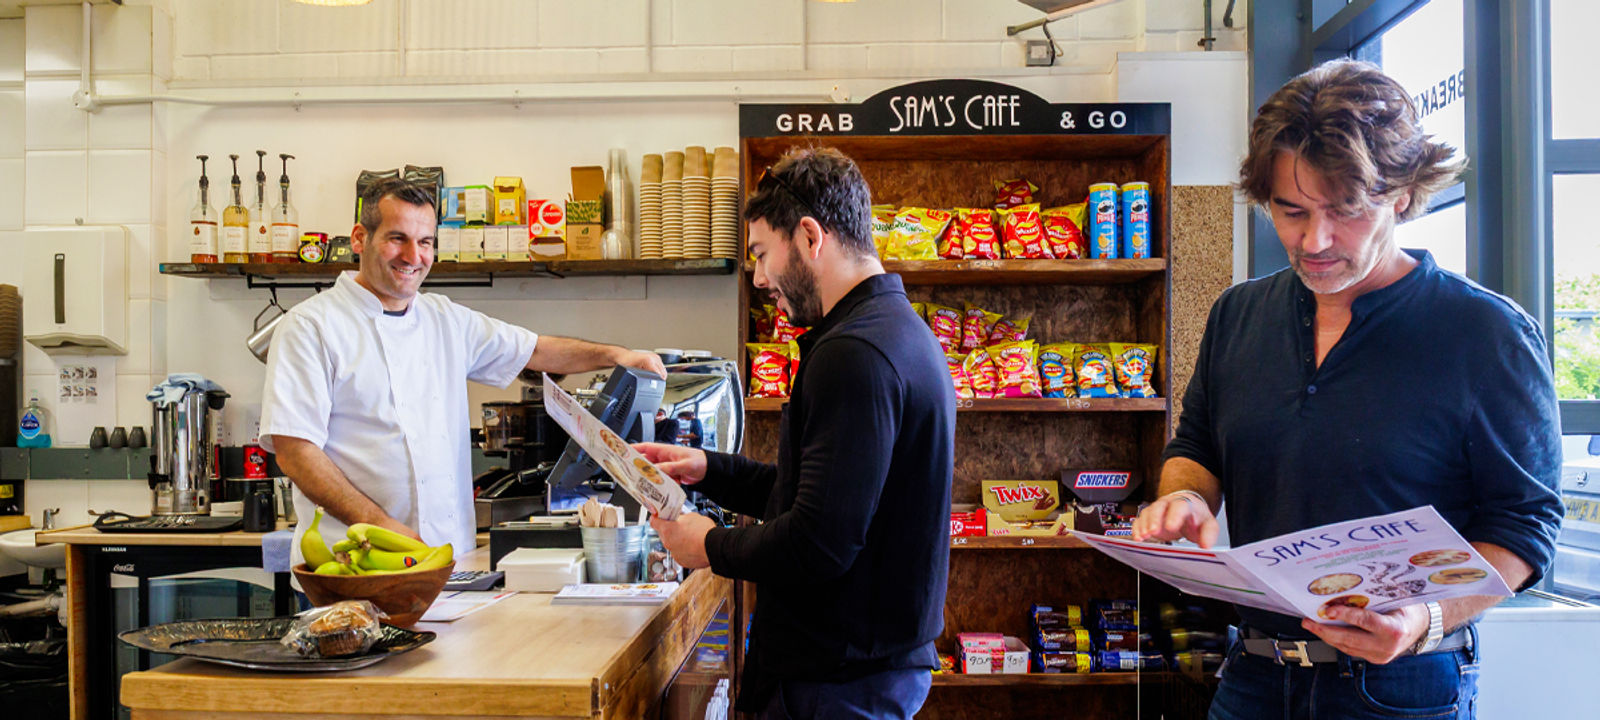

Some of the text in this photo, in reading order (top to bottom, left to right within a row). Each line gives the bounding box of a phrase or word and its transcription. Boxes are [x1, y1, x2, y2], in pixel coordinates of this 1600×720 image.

[776, 94, 1127, 132] GRAB SAM'S CAFE & GO
[1077, 474, 1128, 487] SNICKERS
[1254, 533, 1340, 566] SAM'S
[1348, 519, 1427, 542] CAFE
